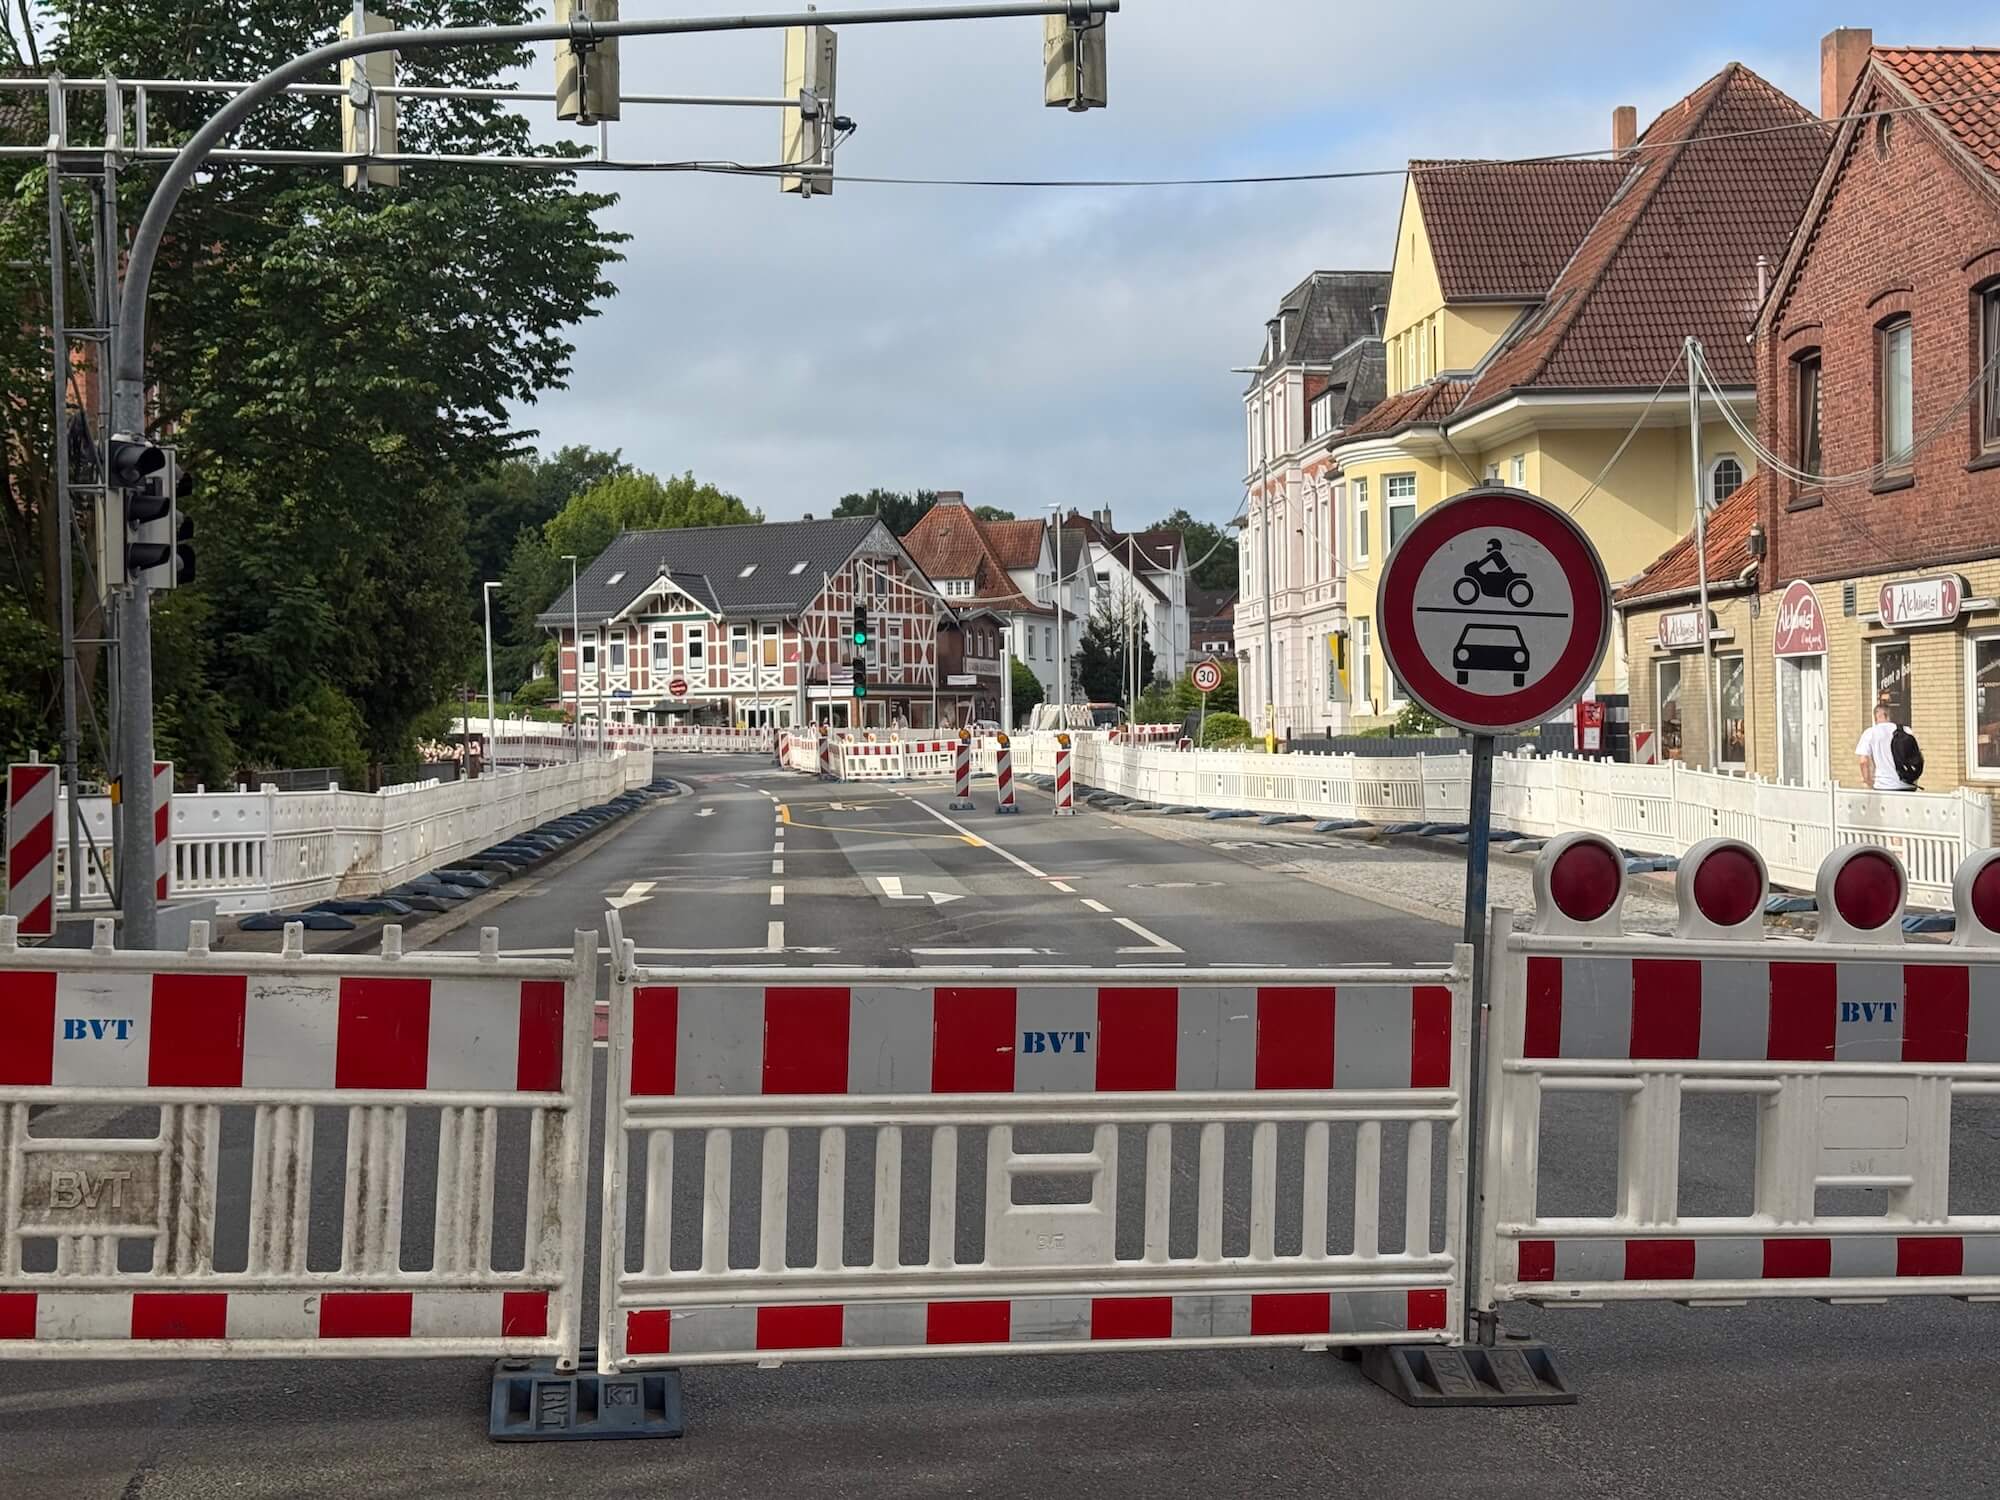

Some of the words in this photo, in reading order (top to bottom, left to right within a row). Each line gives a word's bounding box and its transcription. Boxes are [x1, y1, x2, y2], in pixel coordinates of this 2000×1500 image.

[1199, 670, 1214, 683] 30
[1841, 1001, 1897, 1022] BVT
[63, 1018, 134, 1040] BVT
[1022, 1031, 1091, 1053] BVT
[50, 1170, 132, 1209] BVT
[541, 1390, 568, 1428] BVT
